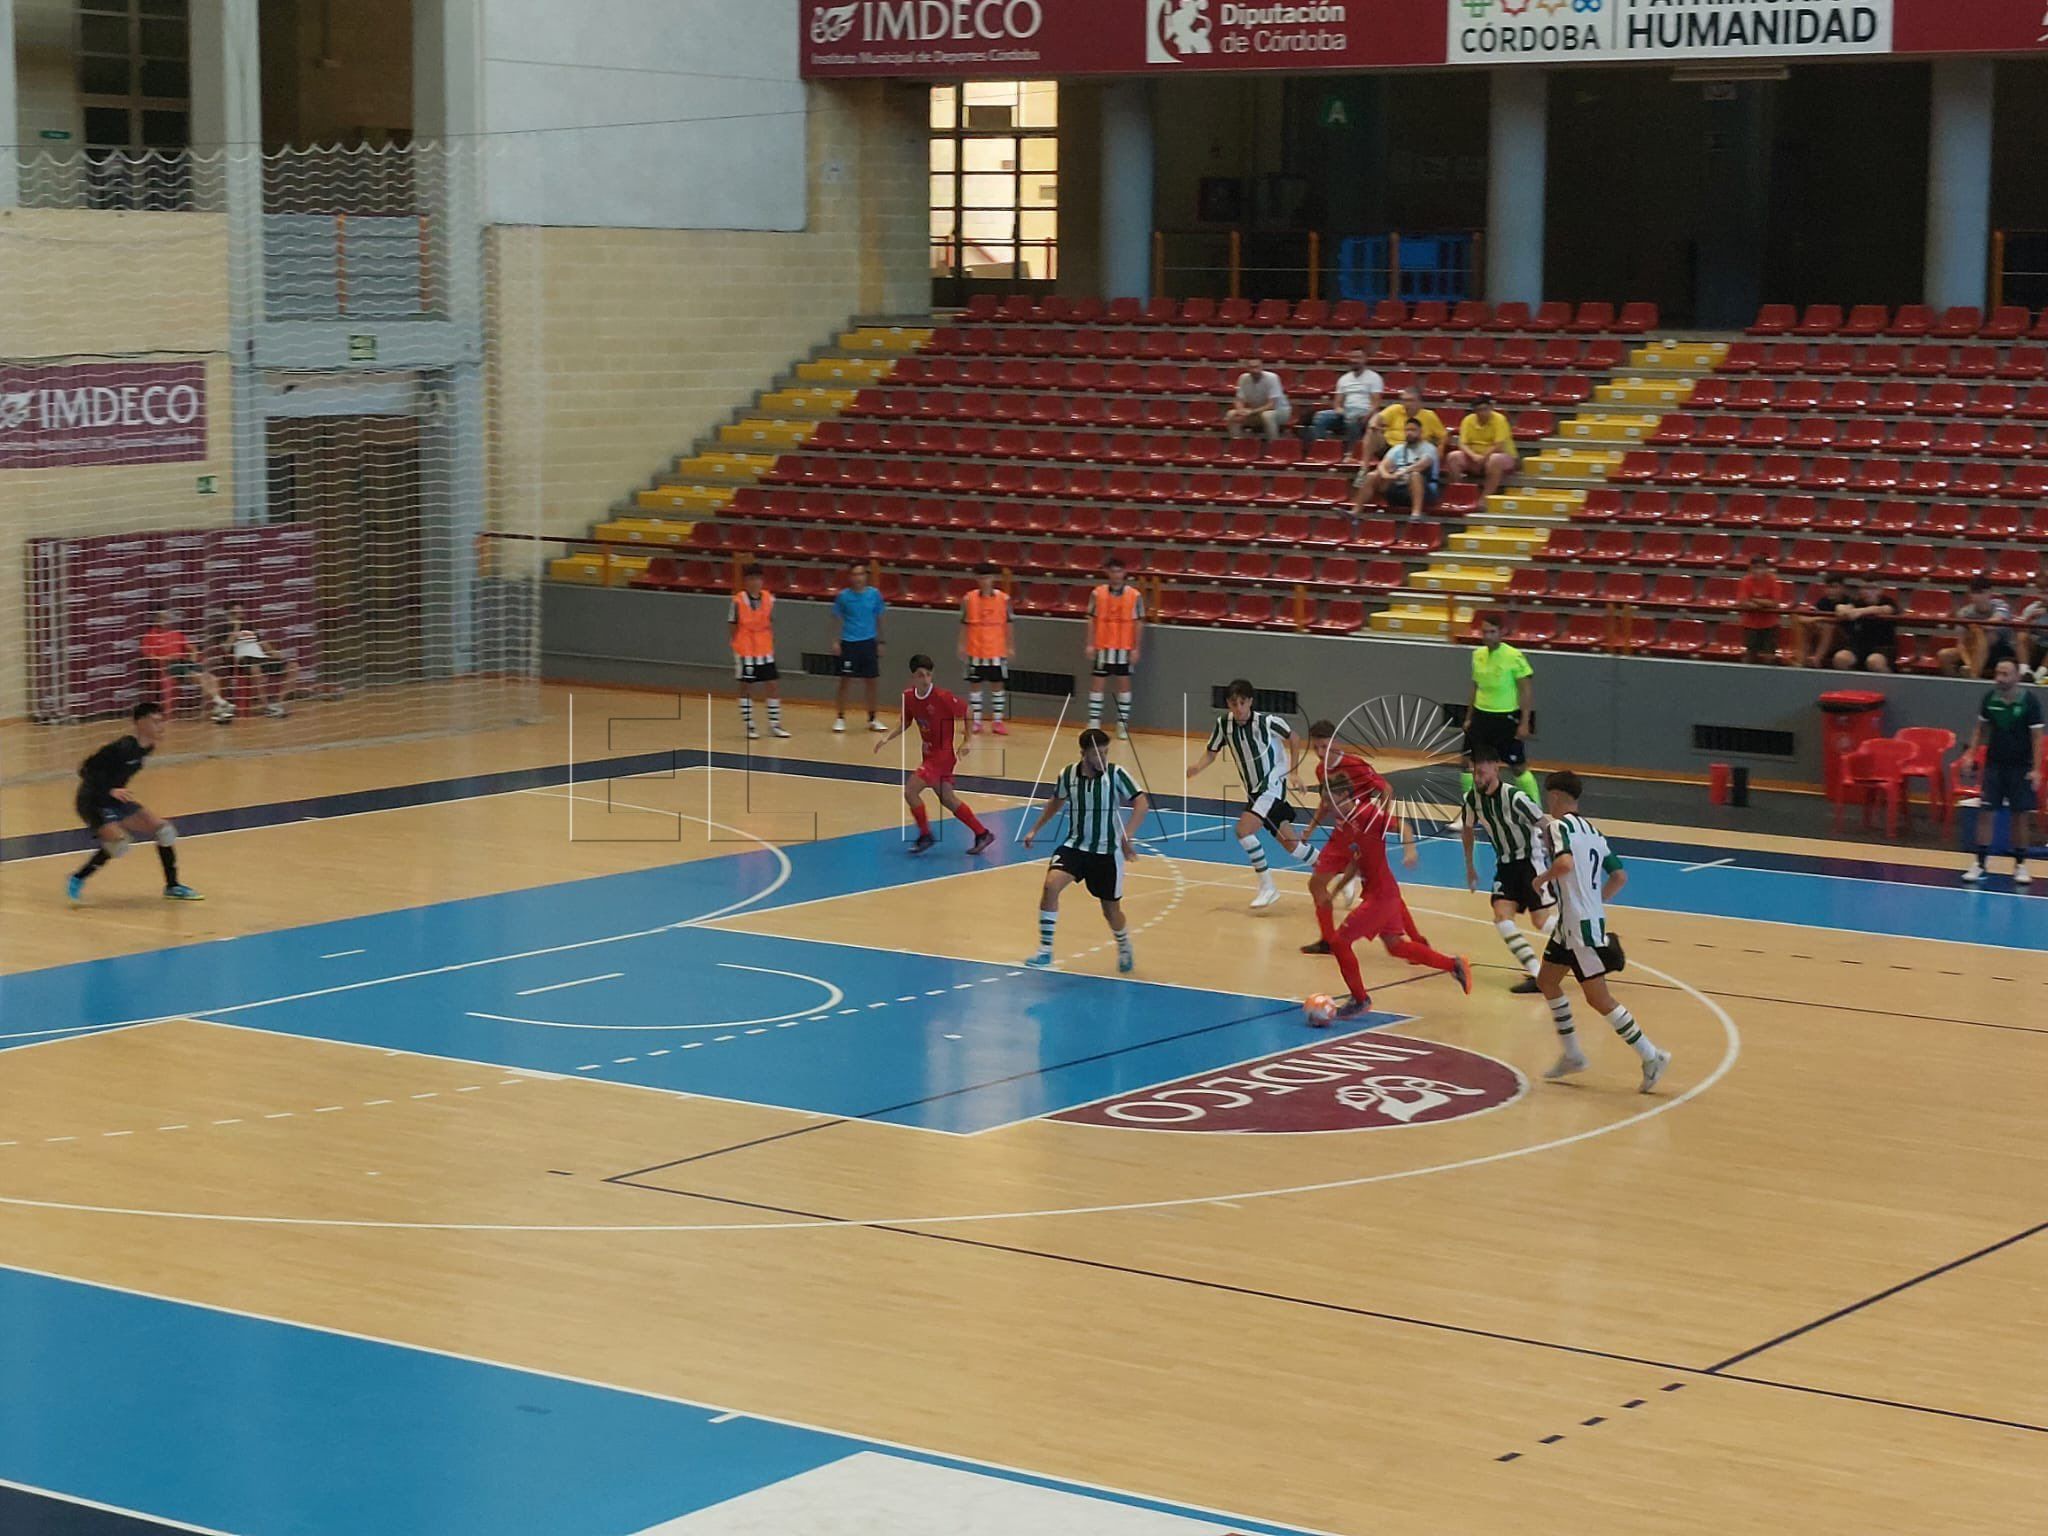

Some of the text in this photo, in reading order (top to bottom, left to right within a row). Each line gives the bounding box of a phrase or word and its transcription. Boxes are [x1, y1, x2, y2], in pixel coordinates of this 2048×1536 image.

[863, 0, 1042, 41] IMDECO
[1221, 0, 1345, 29] Diputación
[1628, 7, 1877, 48] HUMANIDAD
[1220, 29, 1346, 53] de Córdoba
[1461, 22, 1598, 53] CÓRDOBA
[40, 385, 198, 428] IMDECO
[1103, 1041, 1434, 1123] IMDECO
